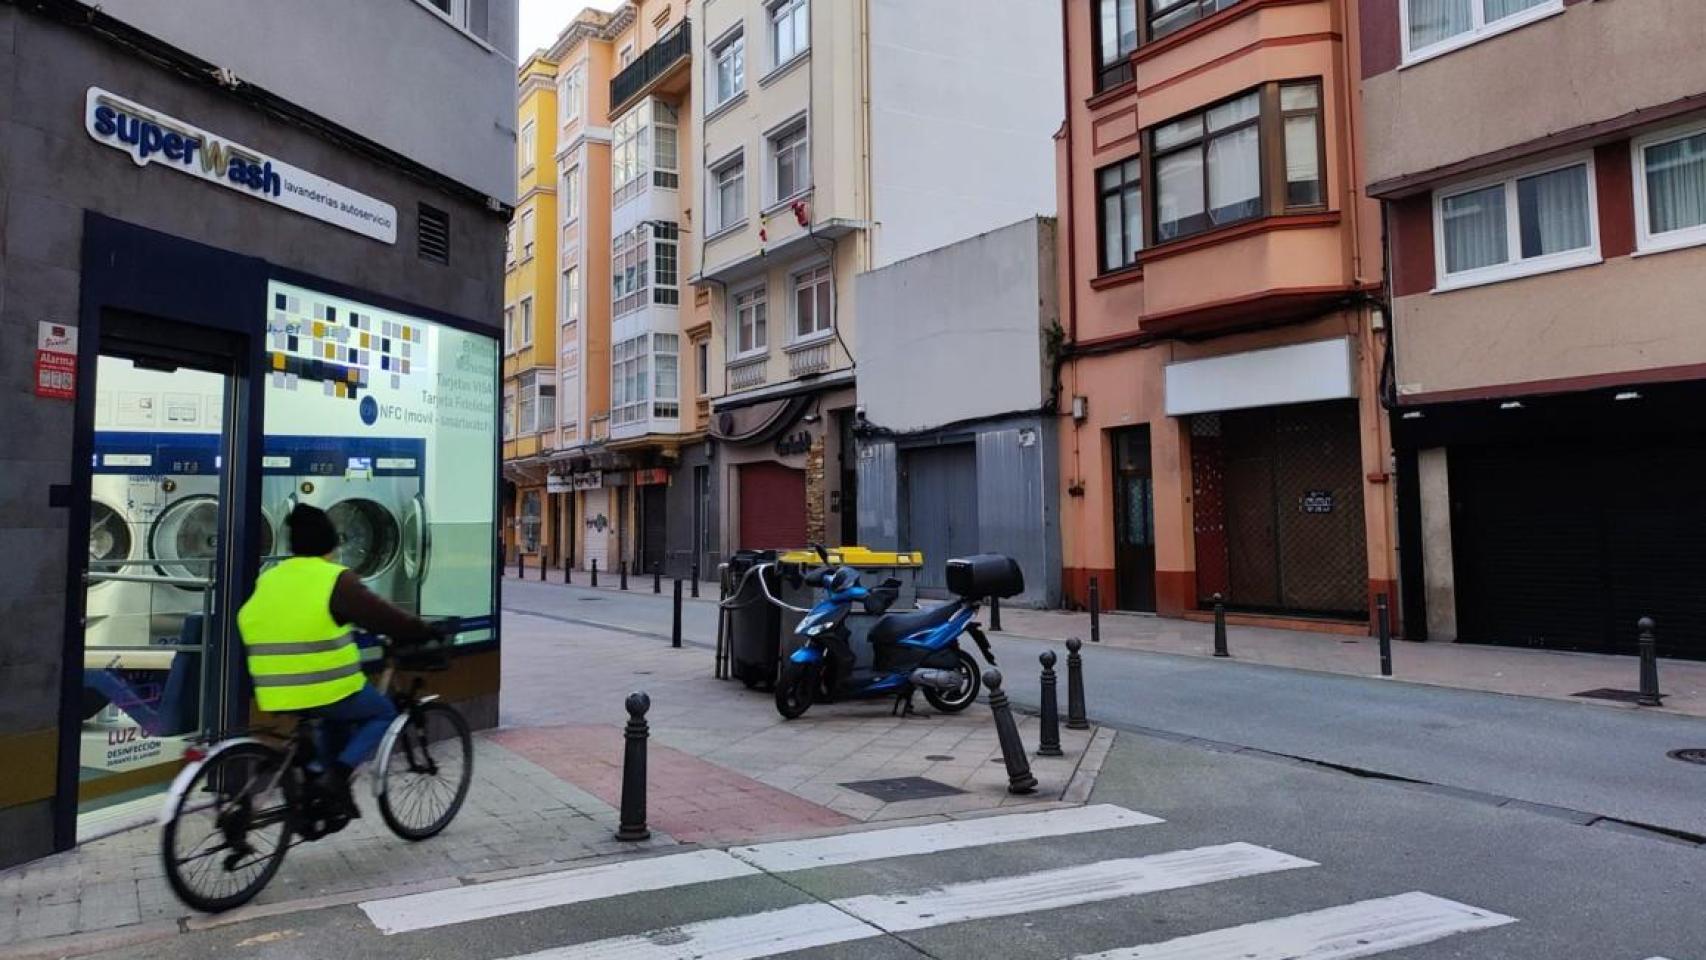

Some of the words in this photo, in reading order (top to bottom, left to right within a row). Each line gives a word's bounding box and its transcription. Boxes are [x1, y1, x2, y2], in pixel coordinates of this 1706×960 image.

[340, 201, 392, 229] autoservicio
[40, 351, 74, 367] Alarma
[422, 390, 454, 408] Tarjeta
[380, 403, 402, 420] NFC
[108, 726, 137, 746] LUZ
